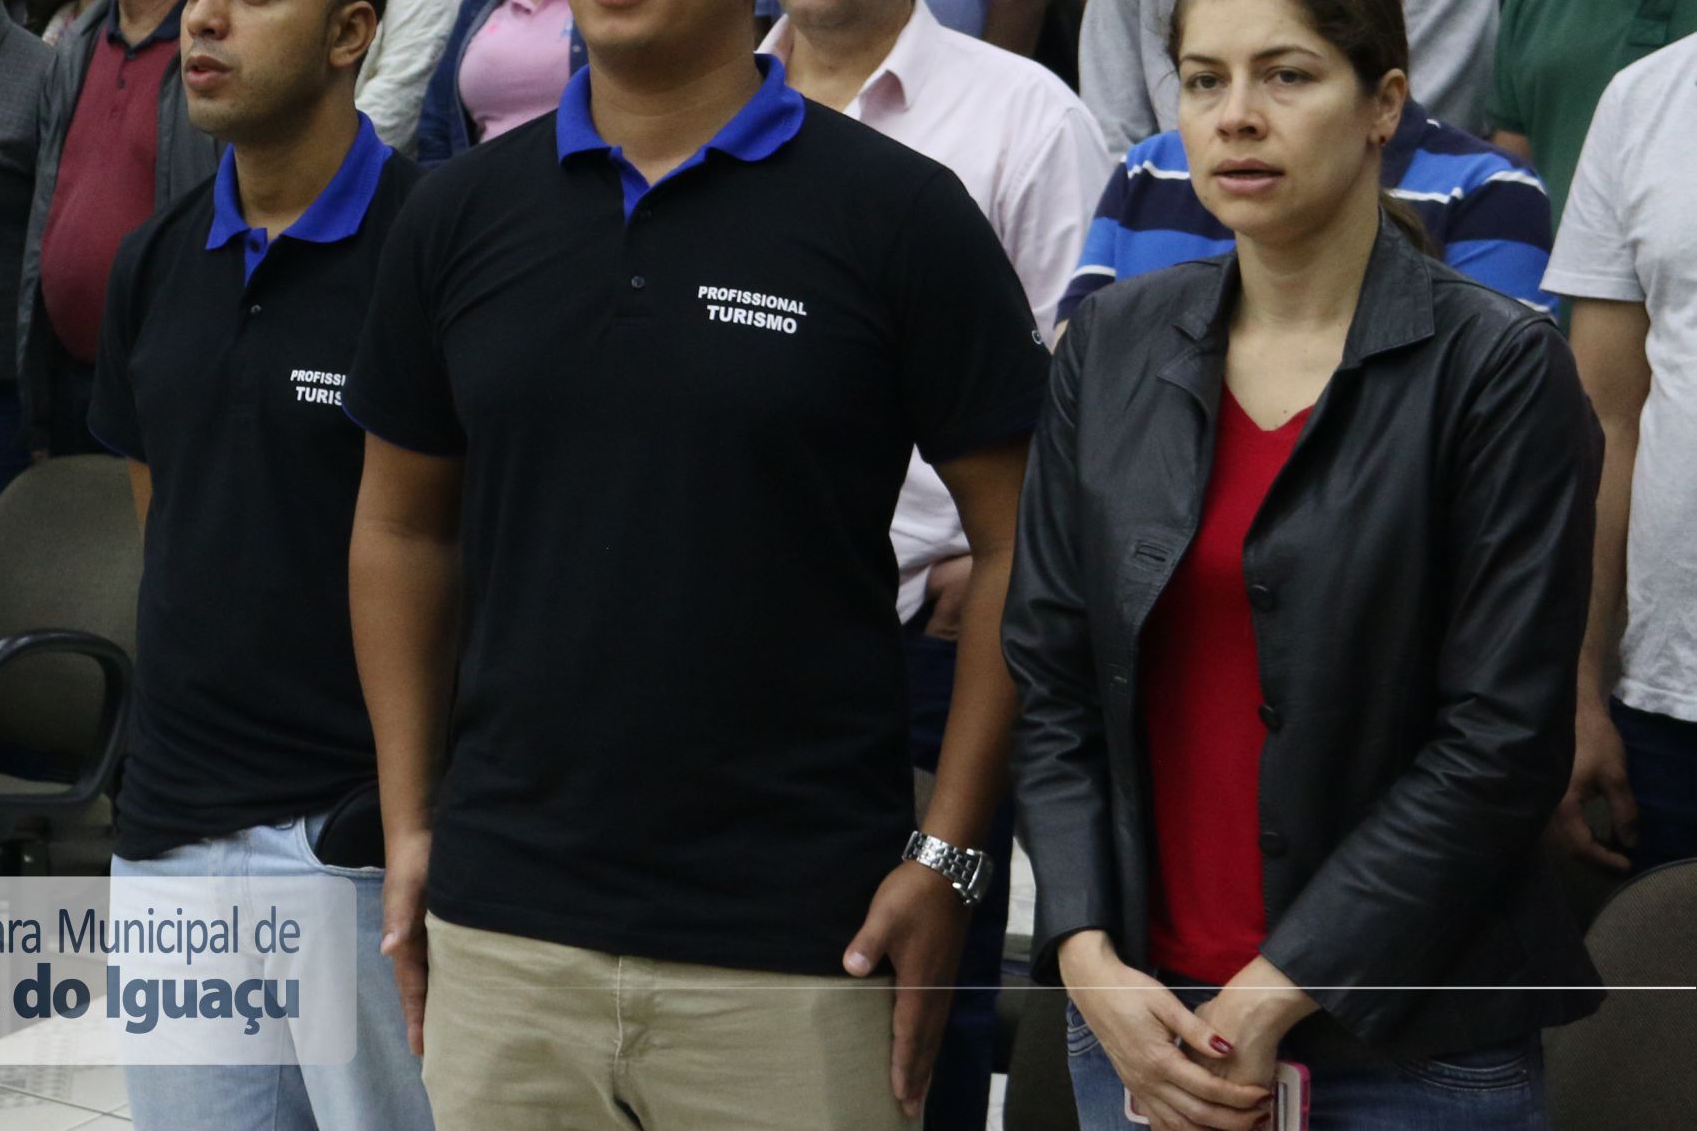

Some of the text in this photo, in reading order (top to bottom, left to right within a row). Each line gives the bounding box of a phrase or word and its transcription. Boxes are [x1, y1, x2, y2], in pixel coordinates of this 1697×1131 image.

[698, 285, 807, 316] PROFISSIONAL
[707, 305, 797, 334] TURISMO
[290, 369, 346, 386] PROFISSI
[296, 386, 342, 406] TURIS
